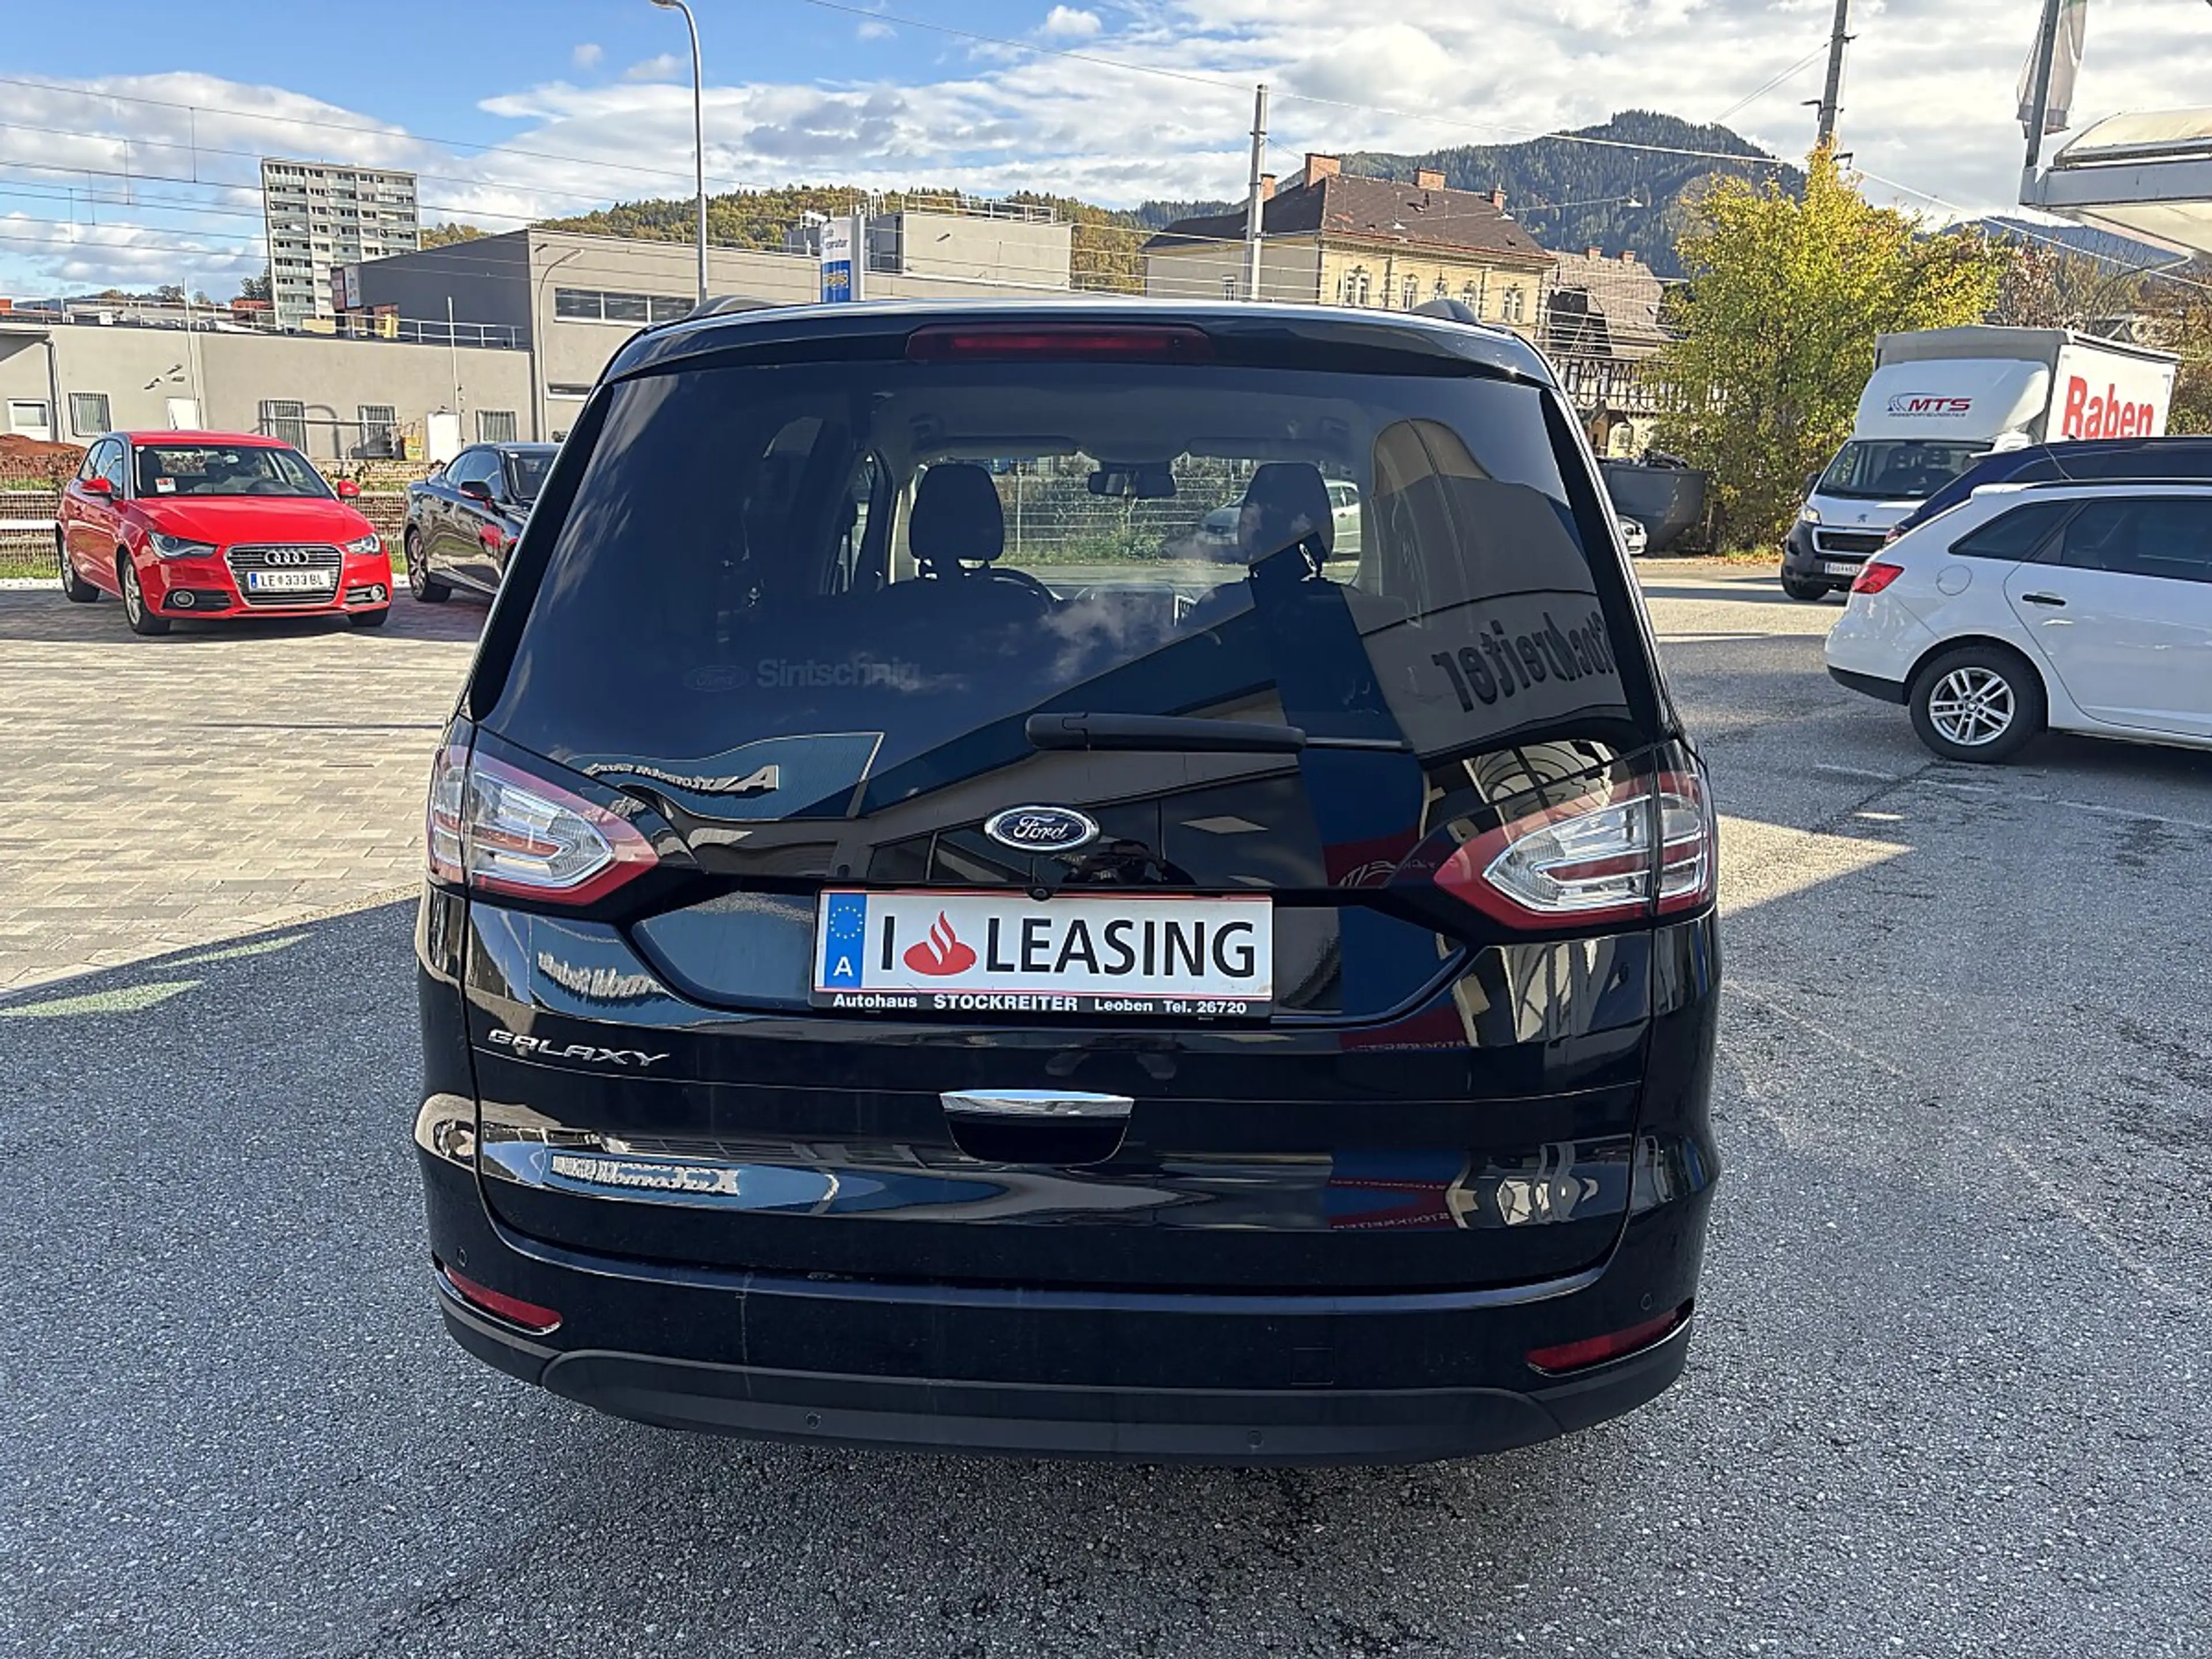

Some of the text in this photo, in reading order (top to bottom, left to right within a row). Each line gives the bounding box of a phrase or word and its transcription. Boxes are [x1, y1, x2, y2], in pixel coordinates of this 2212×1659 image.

[1908, 398, 1973, 411] MTS
[2062, 376, 2154, 439] Raben
[1014, 816, 1069, 840] Ford
[881, 916, 1255, 978] I LEASING
[833, 957, 853, 977] A
[833, 993, 1247, 1015] Autohaus STOCKREITER Leoben Tel. 26720
[488, 1029, 670, 1067] GALAXY
